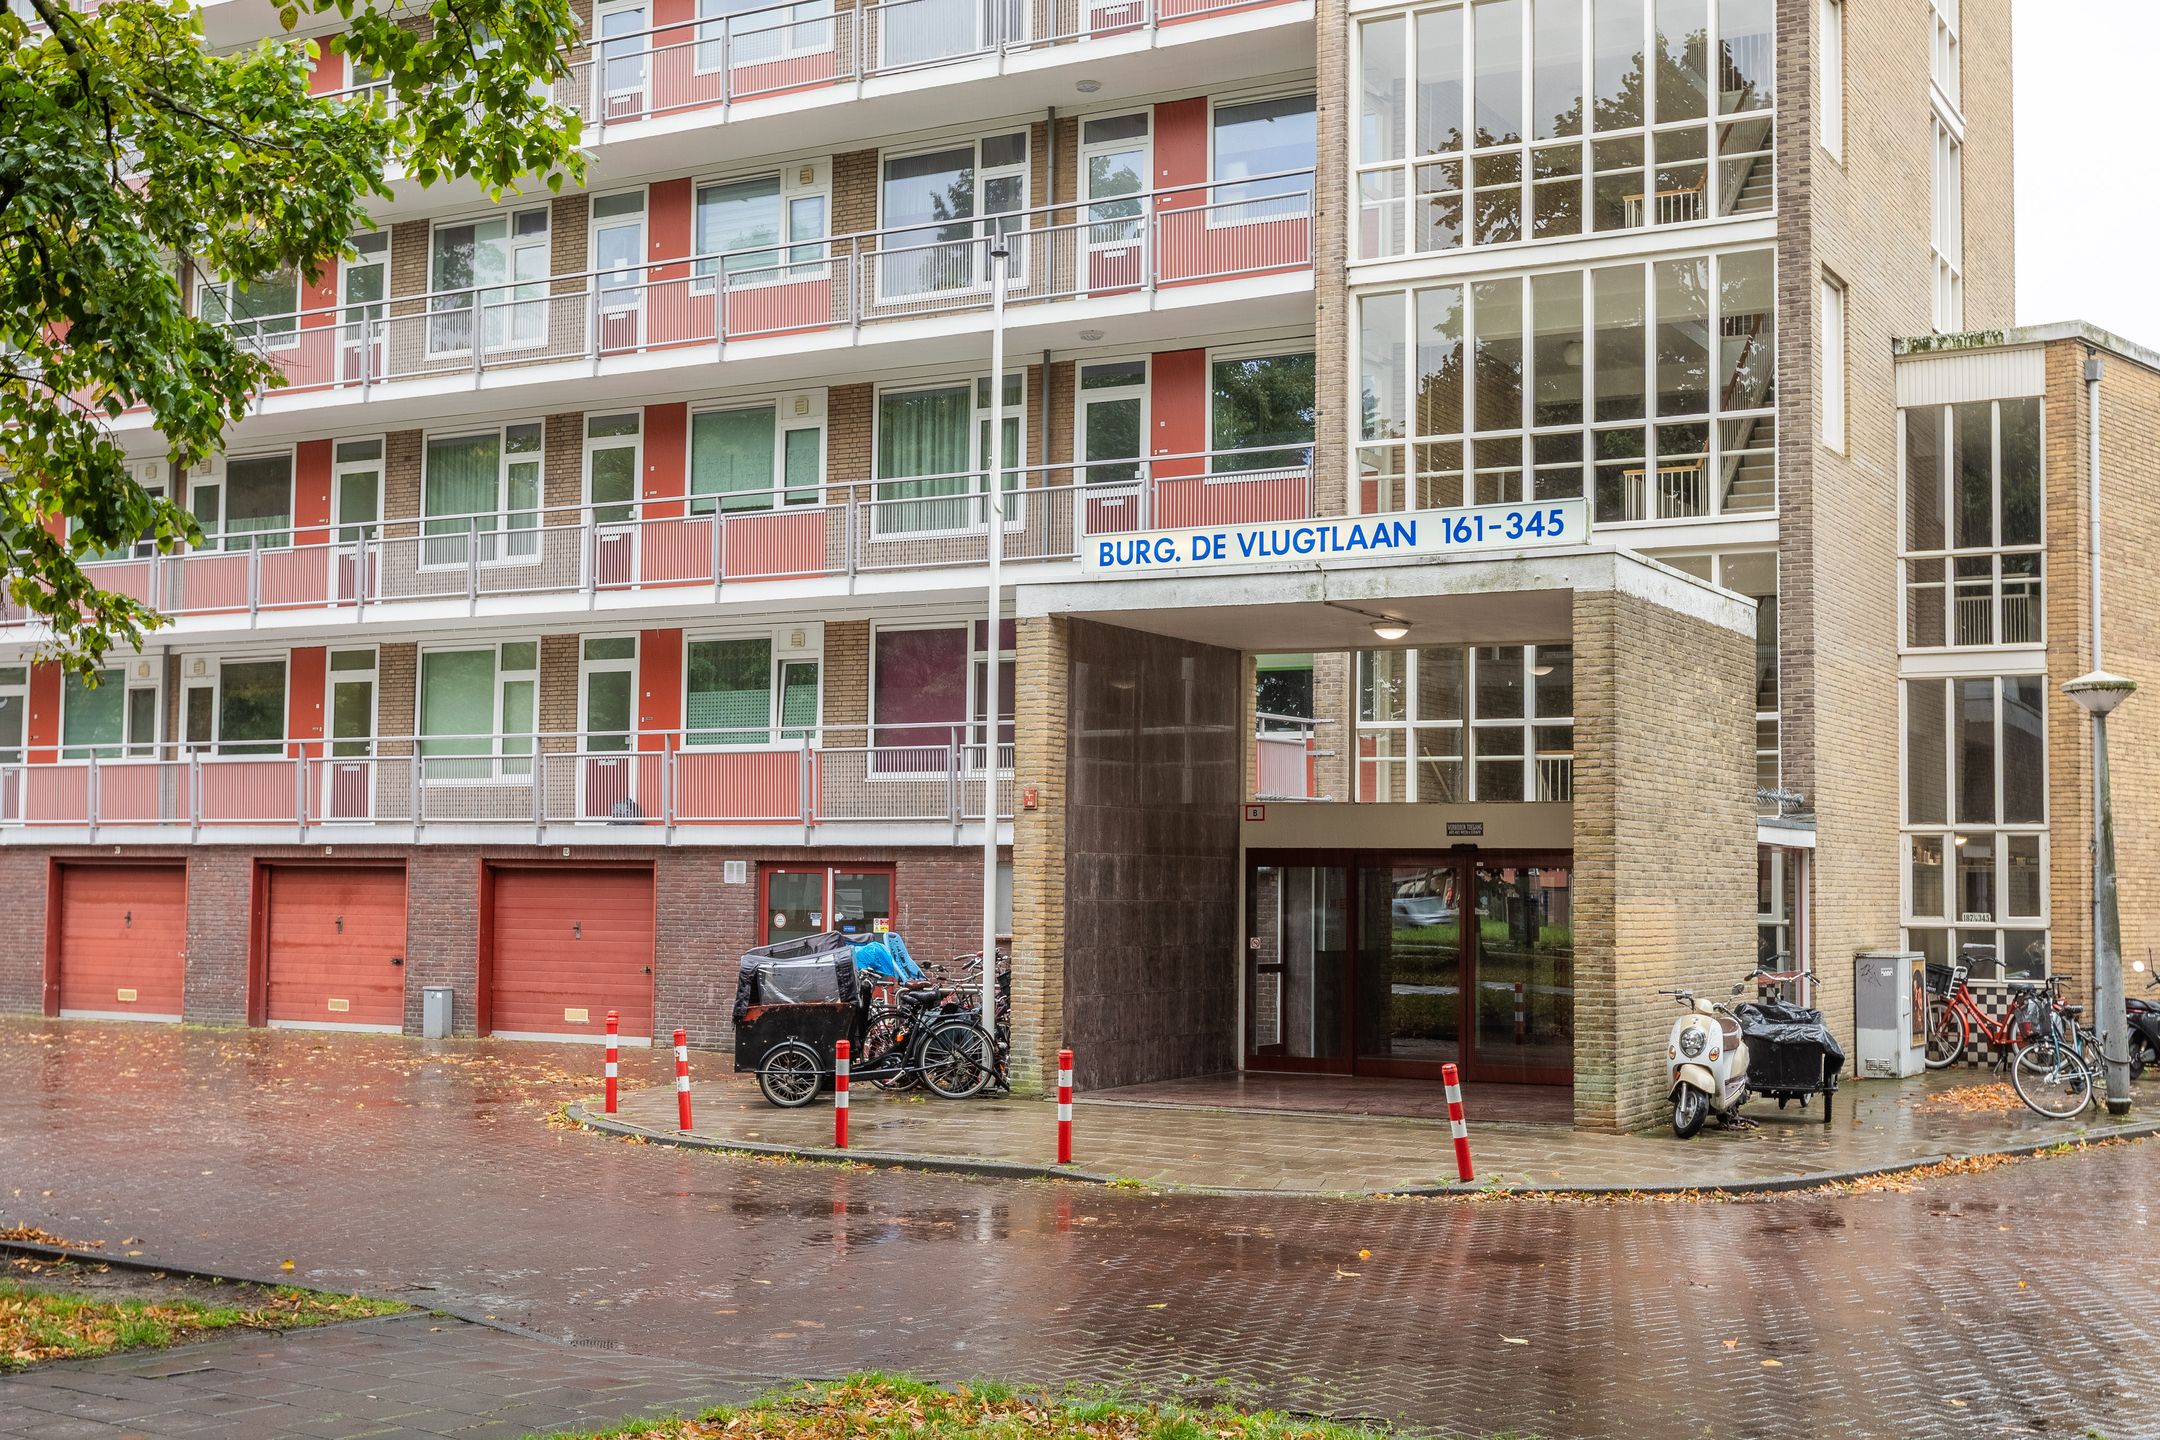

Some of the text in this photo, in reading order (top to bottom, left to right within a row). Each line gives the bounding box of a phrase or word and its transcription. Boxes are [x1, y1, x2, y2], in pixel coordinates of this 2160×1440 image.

[1099, 509, 1565, 567] BURG. DE VLUGTLAAN 161-345
